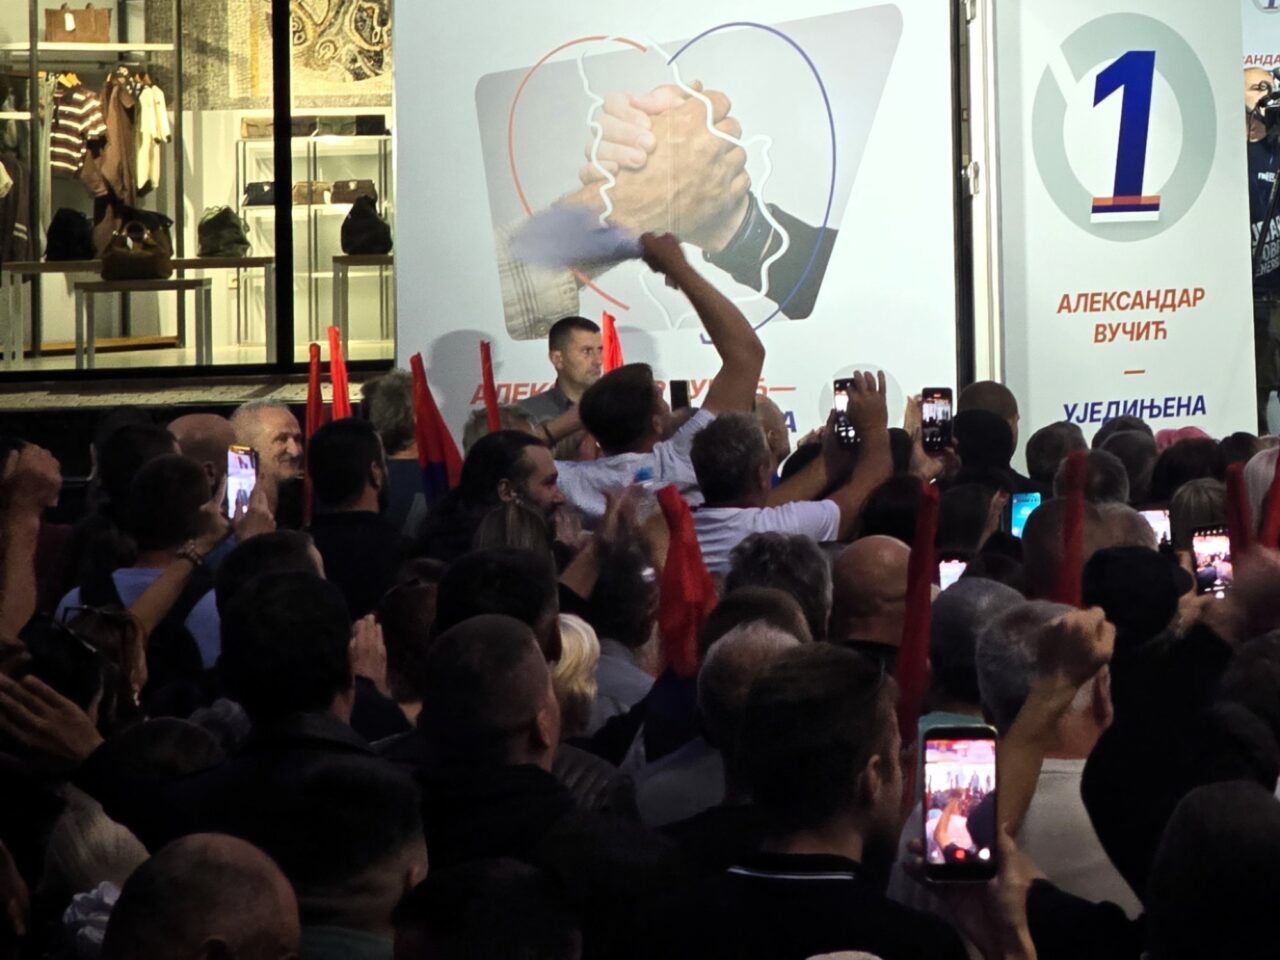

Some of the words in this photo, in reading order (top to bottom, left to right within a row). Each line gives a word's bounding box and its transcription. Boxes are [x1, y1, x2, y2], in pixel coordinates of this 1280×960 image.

[1091, 50, 1161, 216] 1
[1057, 287, 1206, 314] АЛЕКСАНДАР
[1093, 319, 1168, 344] ВУЧИЋ
[1063, 395, 1207, 424] УЈЕДИЊЕНА
